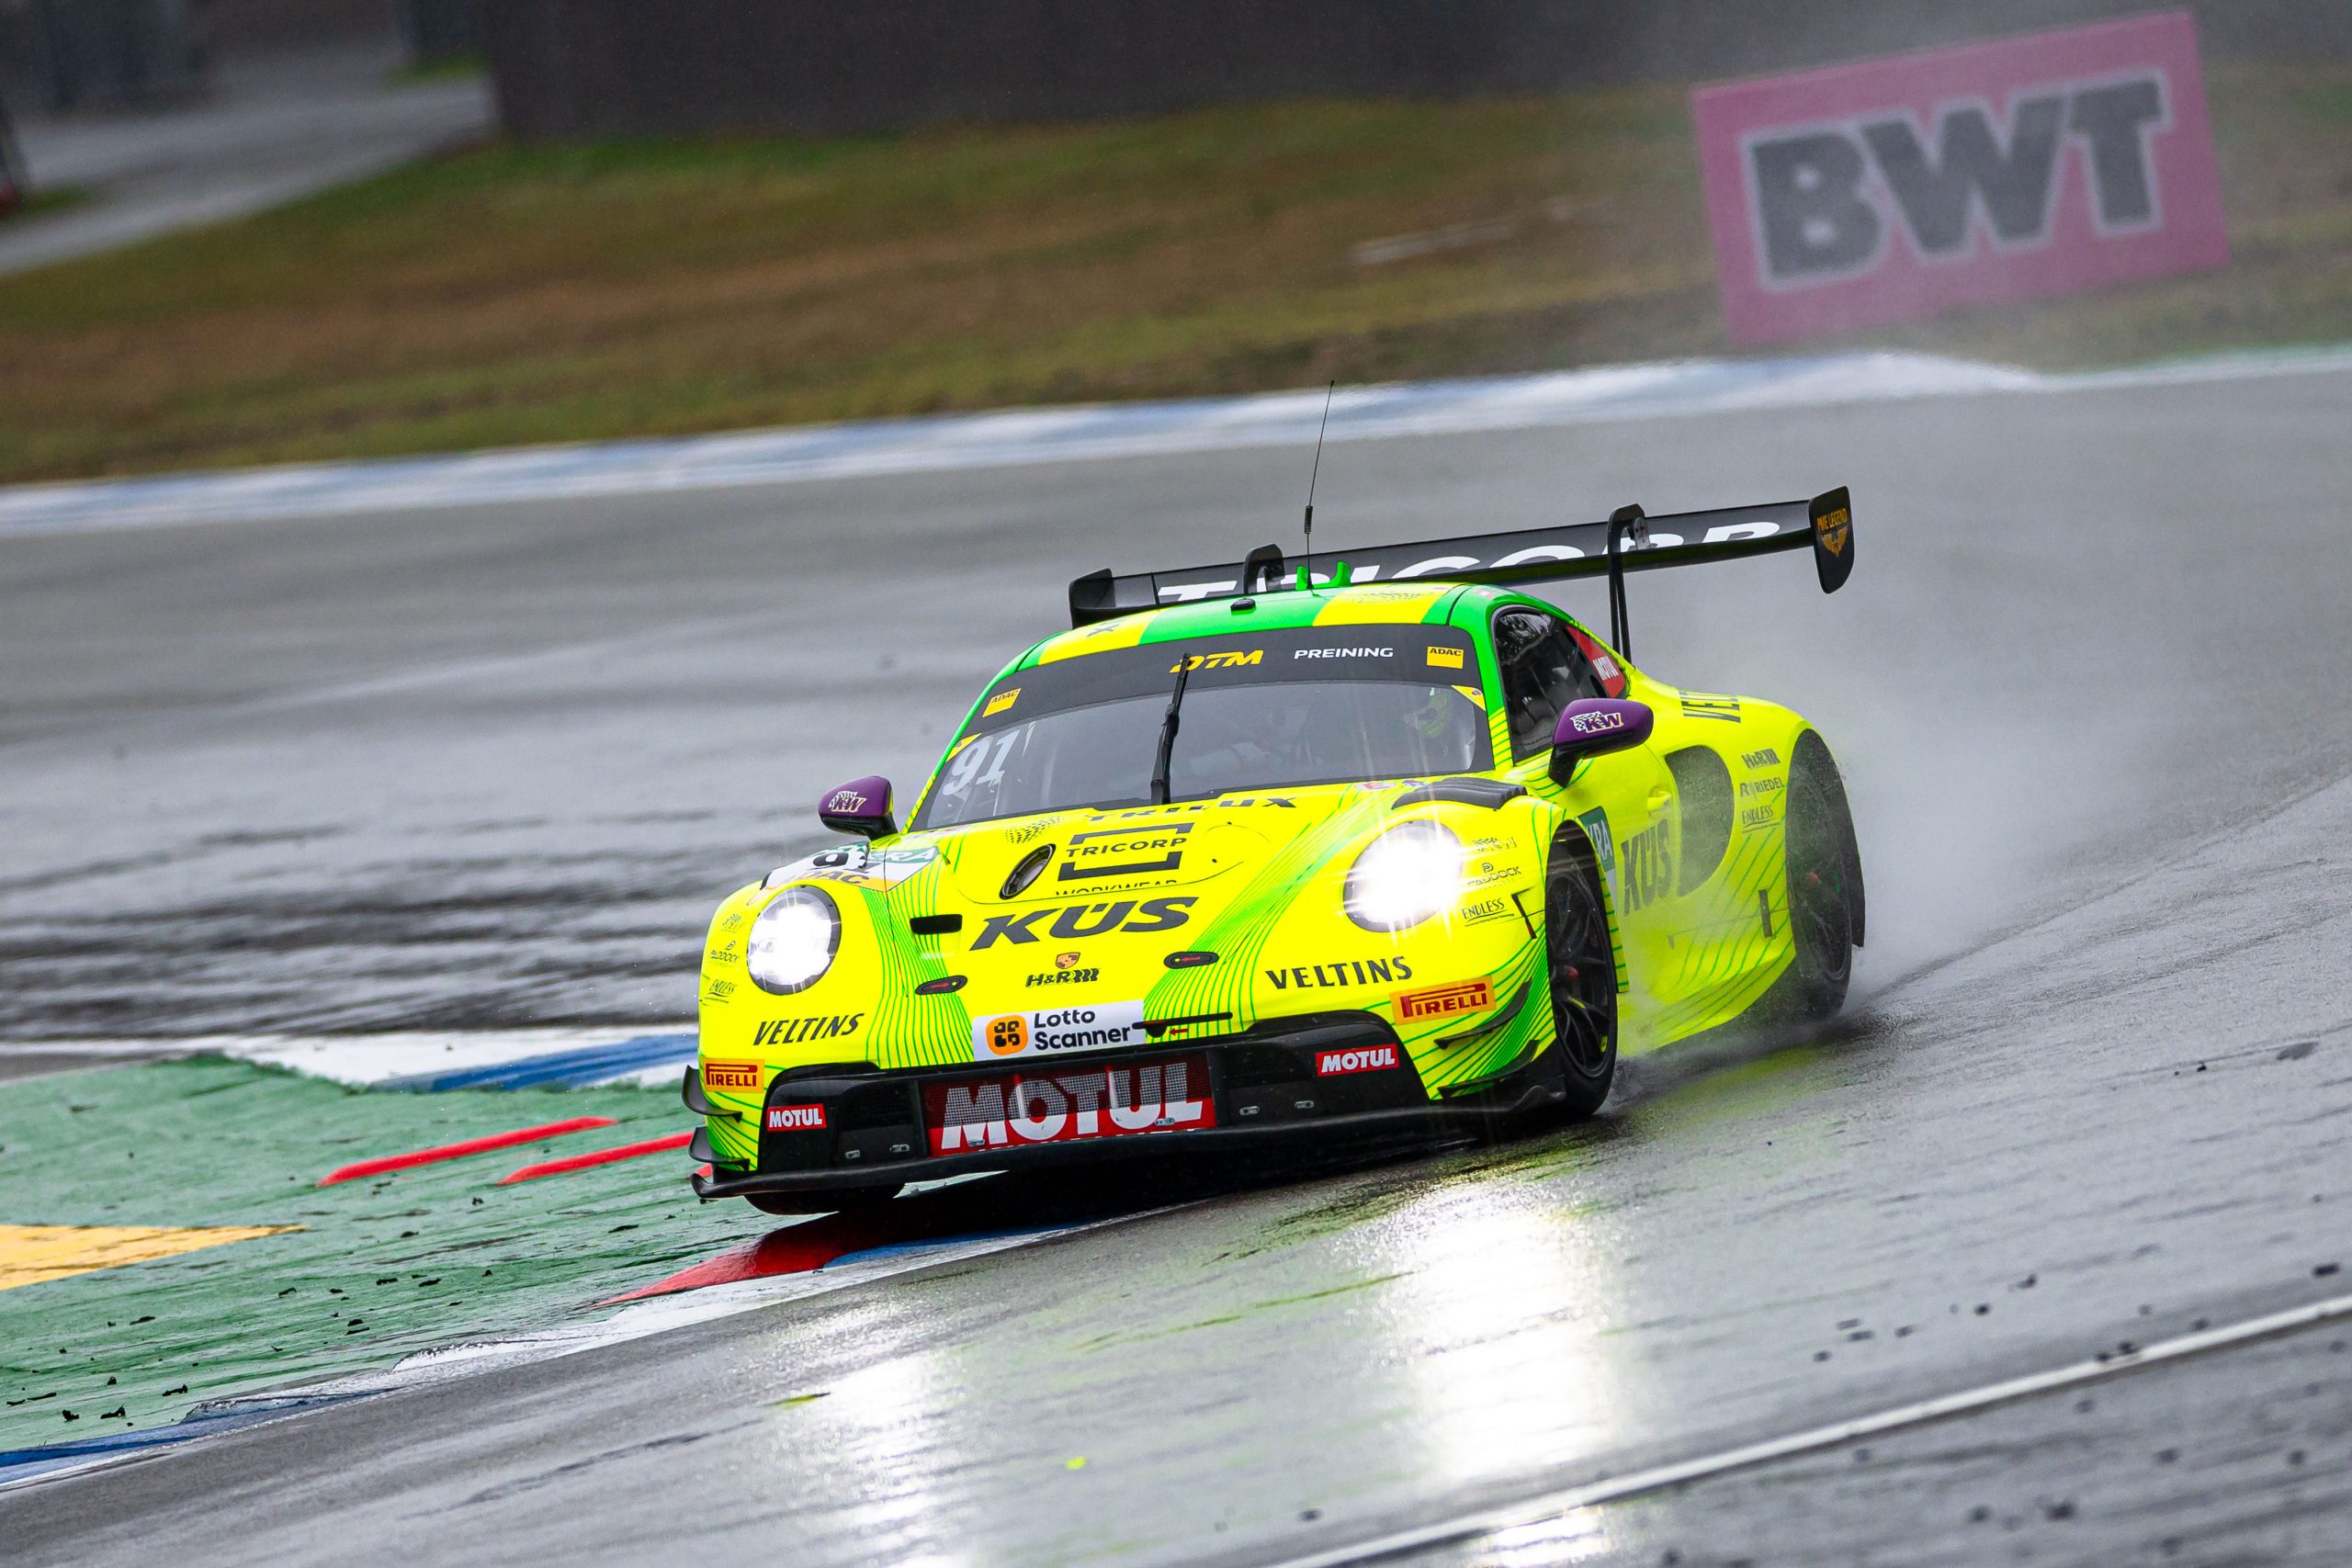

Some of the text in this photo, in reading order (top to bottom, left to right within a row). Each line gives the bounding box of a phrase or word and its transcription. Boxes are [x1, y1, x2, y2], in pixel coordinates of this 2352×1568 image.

[1746, 73, 2166, 285] BWT
[1169, 649, 1263, 673] DTM
[1295, 648, 1394, 660] PREINING
[1430, 648, 1462, 657] ADAC
[1592, 656, 1619, 680] MOTUL
[1583, 713, 1623, 733] KW
[943, 730, 1021, 795] 91
[1754, 776, 1785, 793] RIEDEL
[1742, 805, 1774, 825] ENDLESS
[1066, 838, 1187, 858] TRICORP
[1462, 897, 1505, 919] ENDLESS
[969, 897, 1199, 951] KÜS
[1025, 970, 1076, 987] H&R
[1264, 955, 1412, 989] VELTINS
[1400, 982, 1487, 1018] PIRELLI
[752, 1013, 865, 1045] VELTINS
[1034, 1010, 1096, 1029] Lotto
[1035, 1026, 1131, 1050] Scanner
[1321, 1048, 1395, 1073] MOTUL
[705, 1063, 758, 1087] PIRELLI
[941, 1062, 1204, 1149] MOTUL
[768, 1108, 823, 1128] MOTUL
